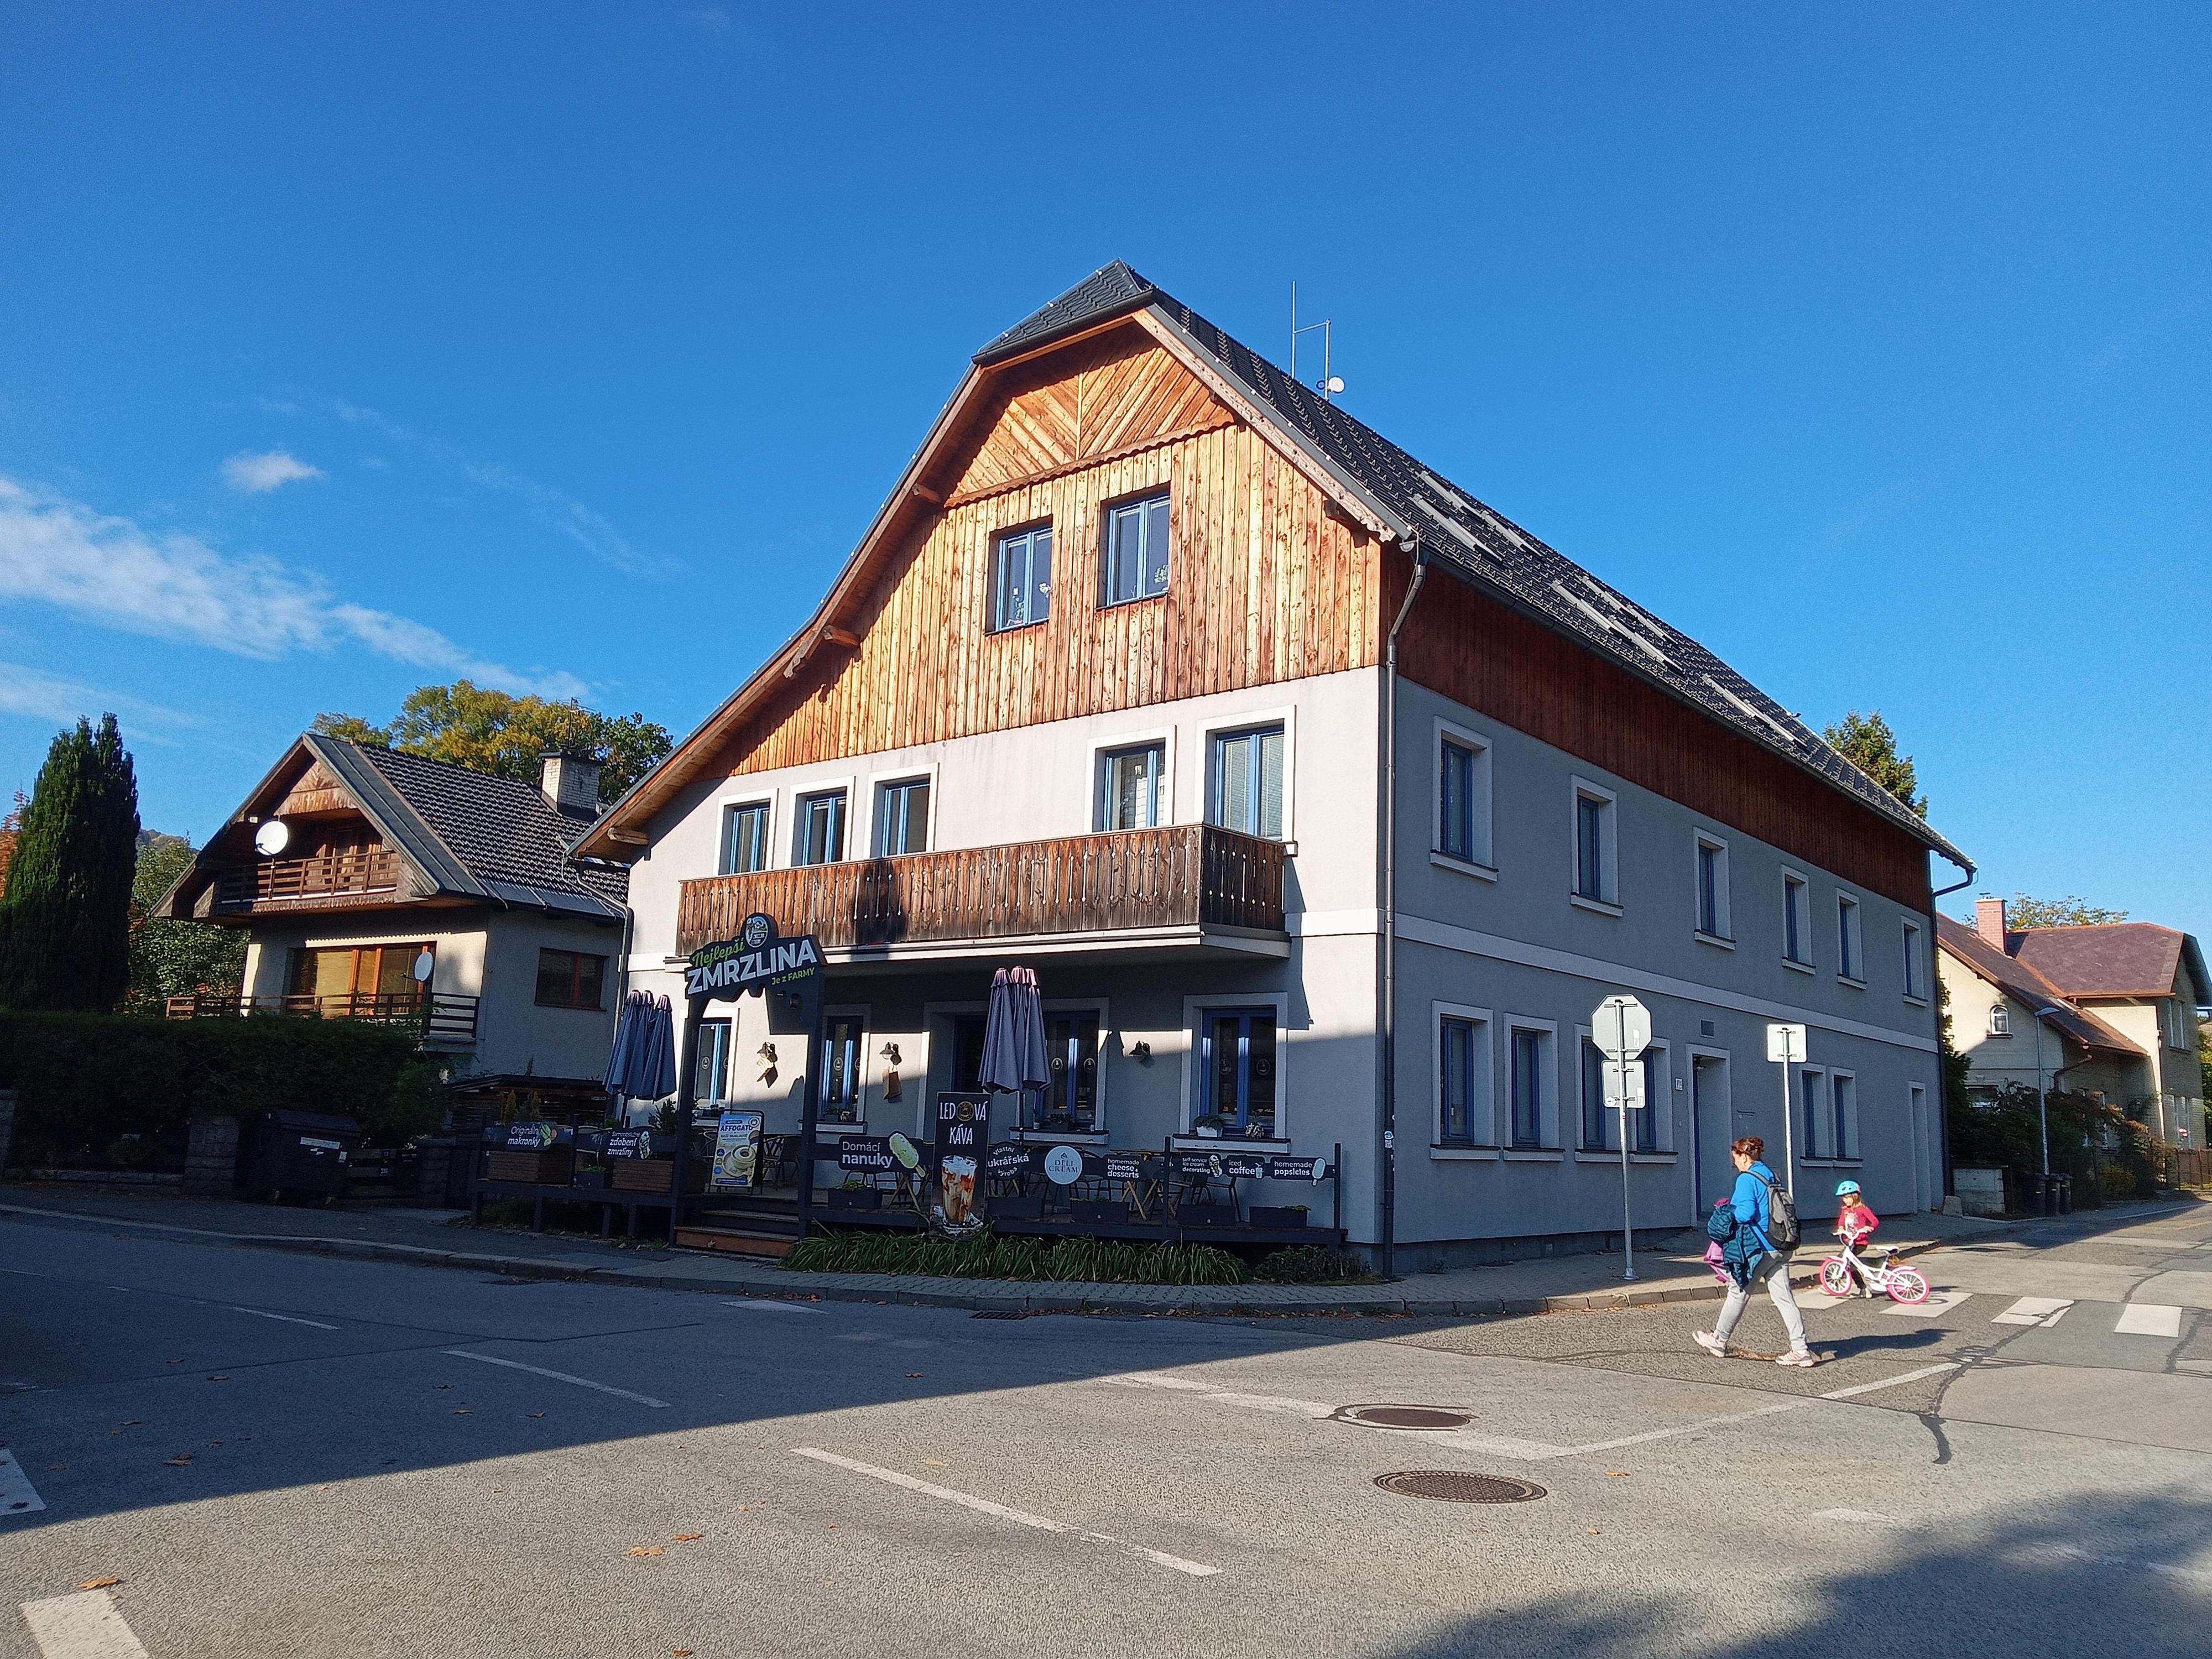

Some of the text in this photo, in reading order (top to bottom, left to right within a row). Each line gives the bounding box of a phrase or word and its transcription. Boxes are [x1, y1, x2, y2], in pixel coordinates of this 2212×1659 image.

[692, 937, 745, 968] Nejlepší
[687, 939, 817, 995] ZMRZLINA
[787, 967, 815, 981] FARMY
[949, 1123, 973, 1145] KÁVA
[507, 1136, 540, 1147] makronky
[609, 1137, 638, 1146] zdobení
[842, 1141, 880, 1152] Domácí
[607, 1147, 633, 1157] zmrzliny
[993, 1146, 1015, 1155] Vlastní
[842, 1152, 893, 1168] nanuky
[987, 1153, 1030, 1167] ukrářská
[1107, 1163, 1134, 1171] cheese
[1229, 1166, 1255, 1175] coffee
[1274, 1168, 1310, 1176] popsicles
[1107, 1170, 1139, 1178] desserts
